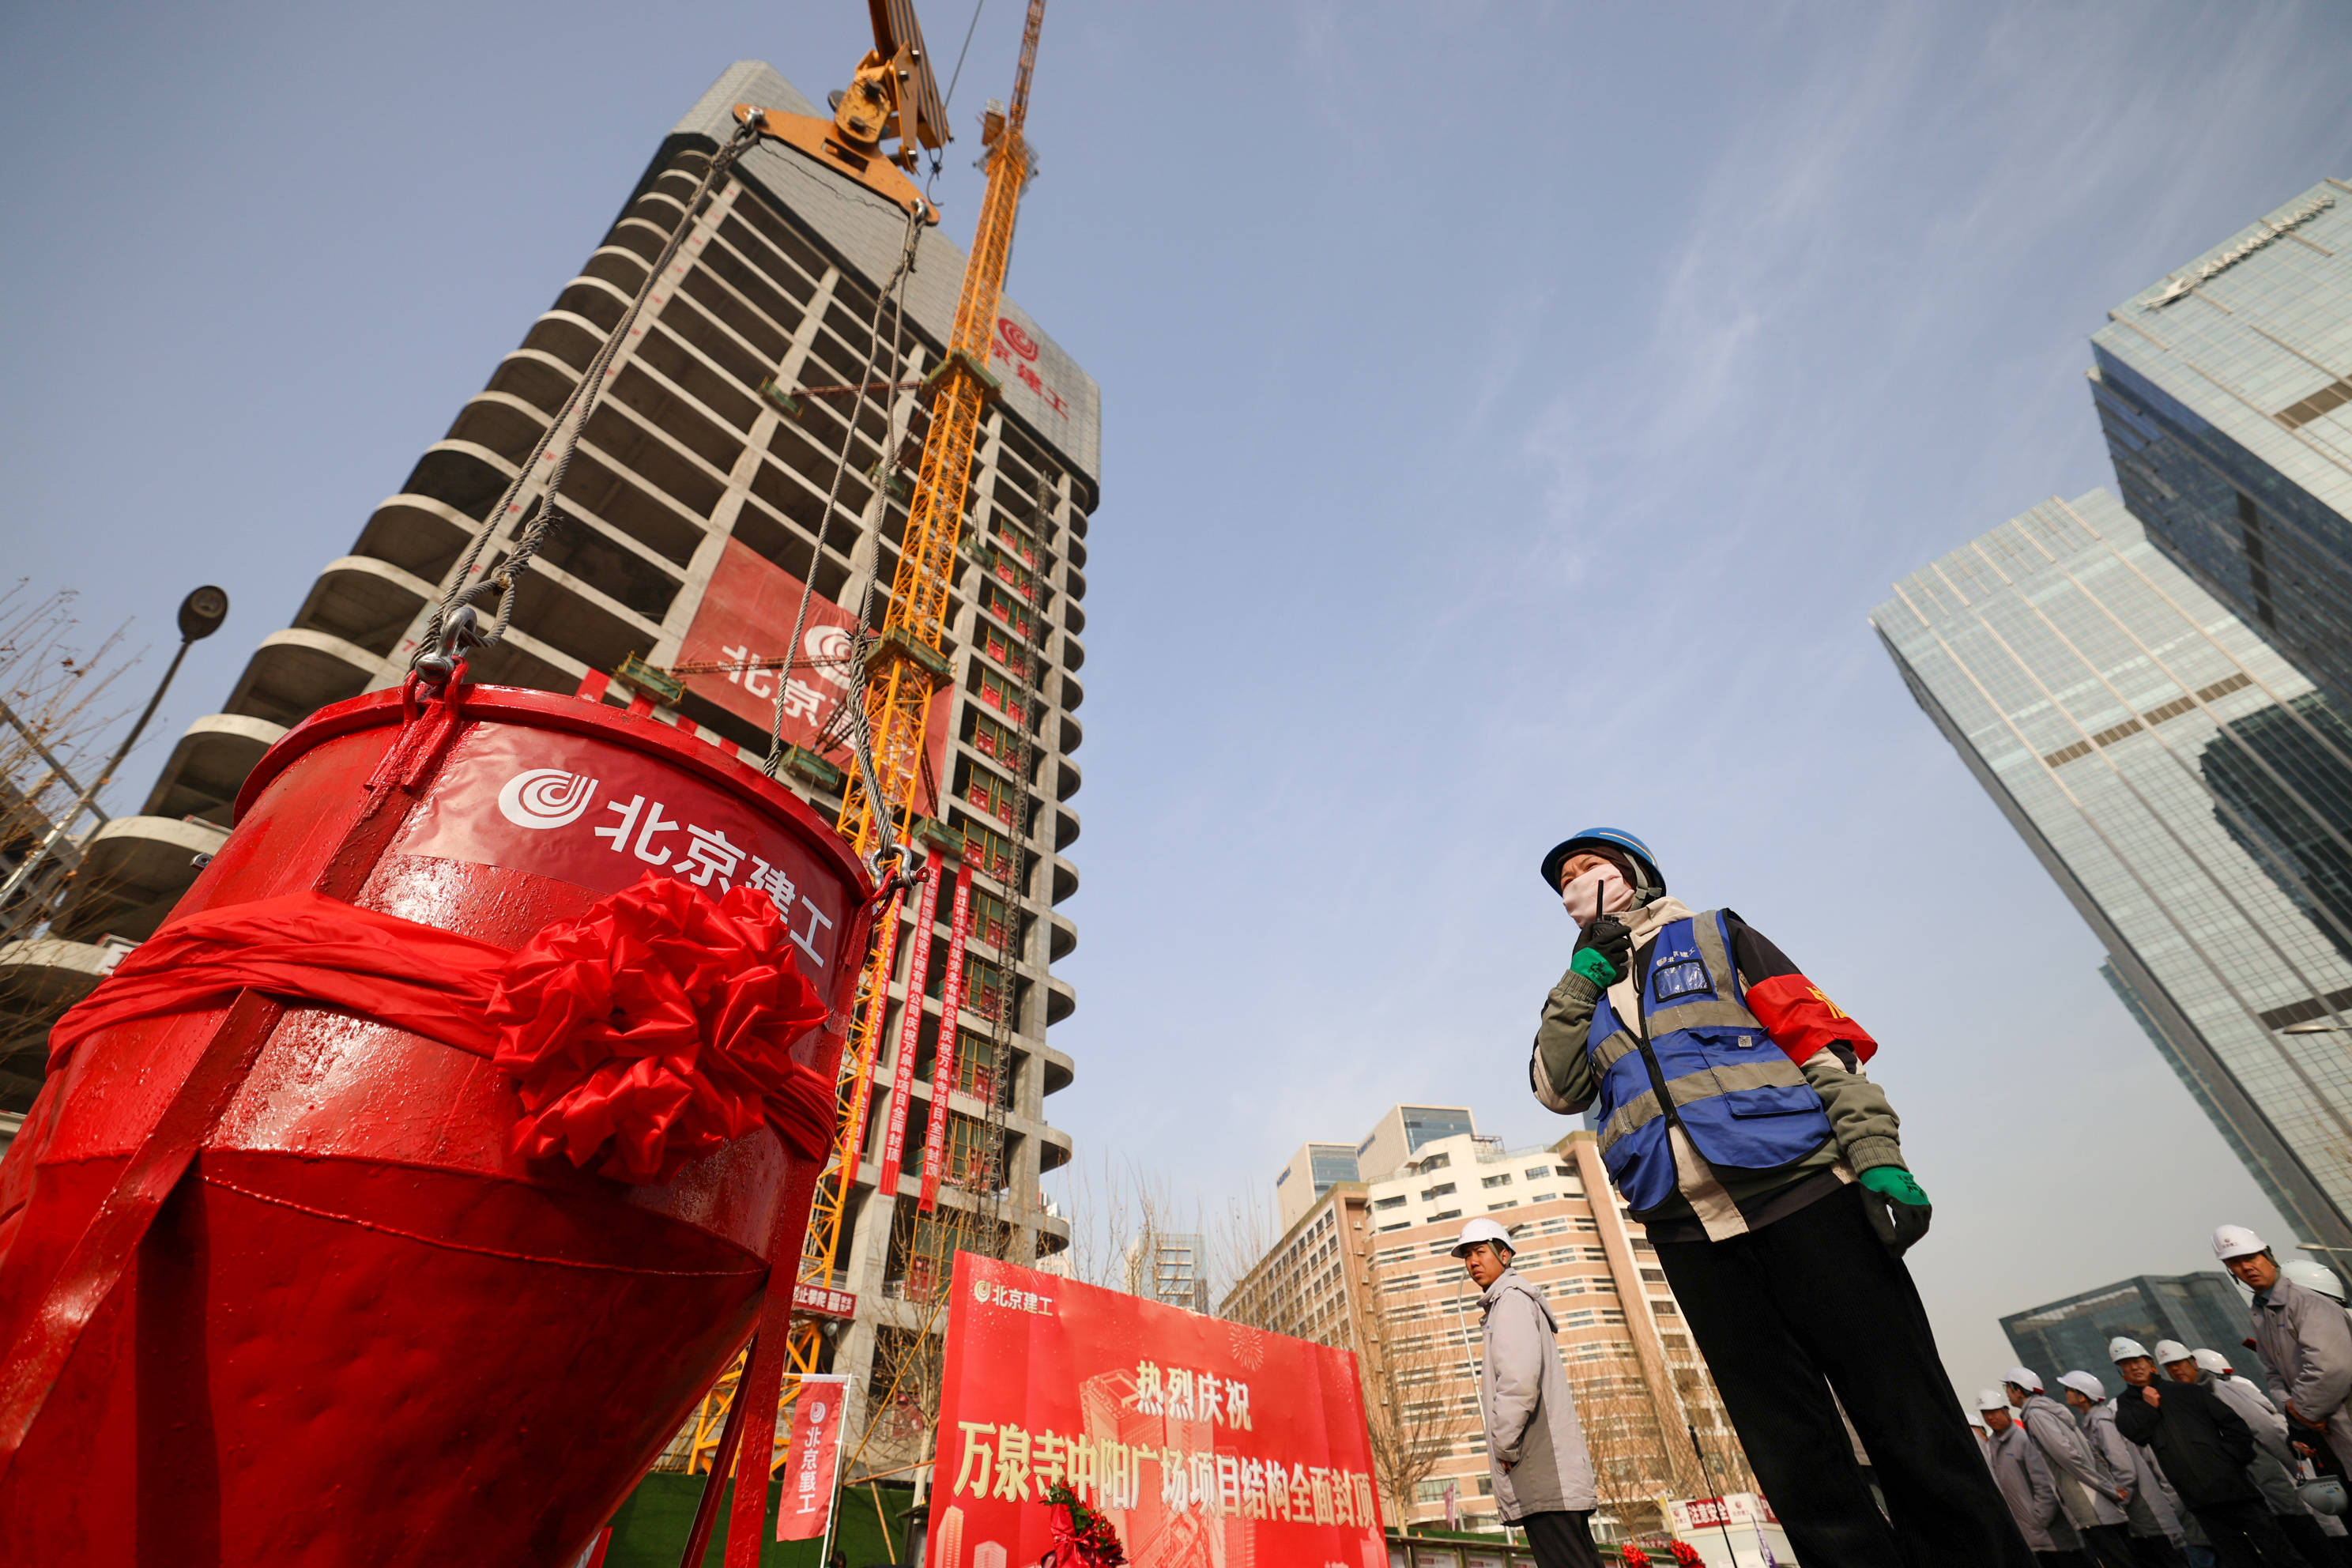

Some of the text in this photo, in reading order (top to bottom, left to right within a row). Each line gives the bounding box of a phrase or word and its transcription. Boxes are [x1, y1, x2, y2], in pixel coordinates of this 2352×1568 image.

[594, 794, 834, 968] 北京建工
[992, 1284, 1054, 1317] 北京建工
[1136, 1359, 1253, 1432] 热烈庆祝
[953, 1420, 1378, 1529] 万泉寺中阳广场项目结构全面封顶
[1689, 1502, 1729, 1524] 注意安全
